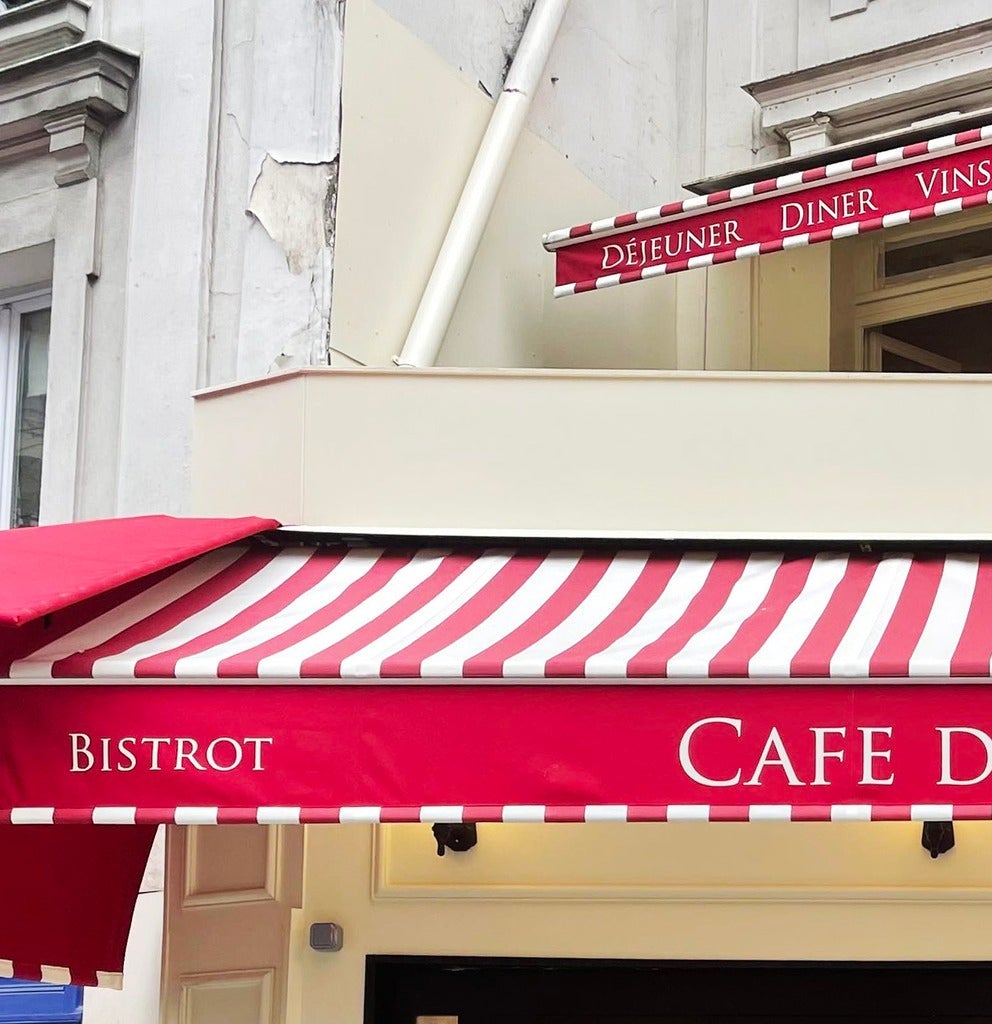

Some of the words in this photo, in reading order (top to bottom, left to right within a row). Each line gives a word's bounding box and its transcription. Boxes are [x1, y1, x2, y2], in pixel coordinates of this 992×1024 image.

[600, 219, 744, 271] DÉJEUNER
[780, 187, 879, 234] DINER
[68, 733, 273, 773] BISTROT
[677, 715, 896, 787] CAFE
